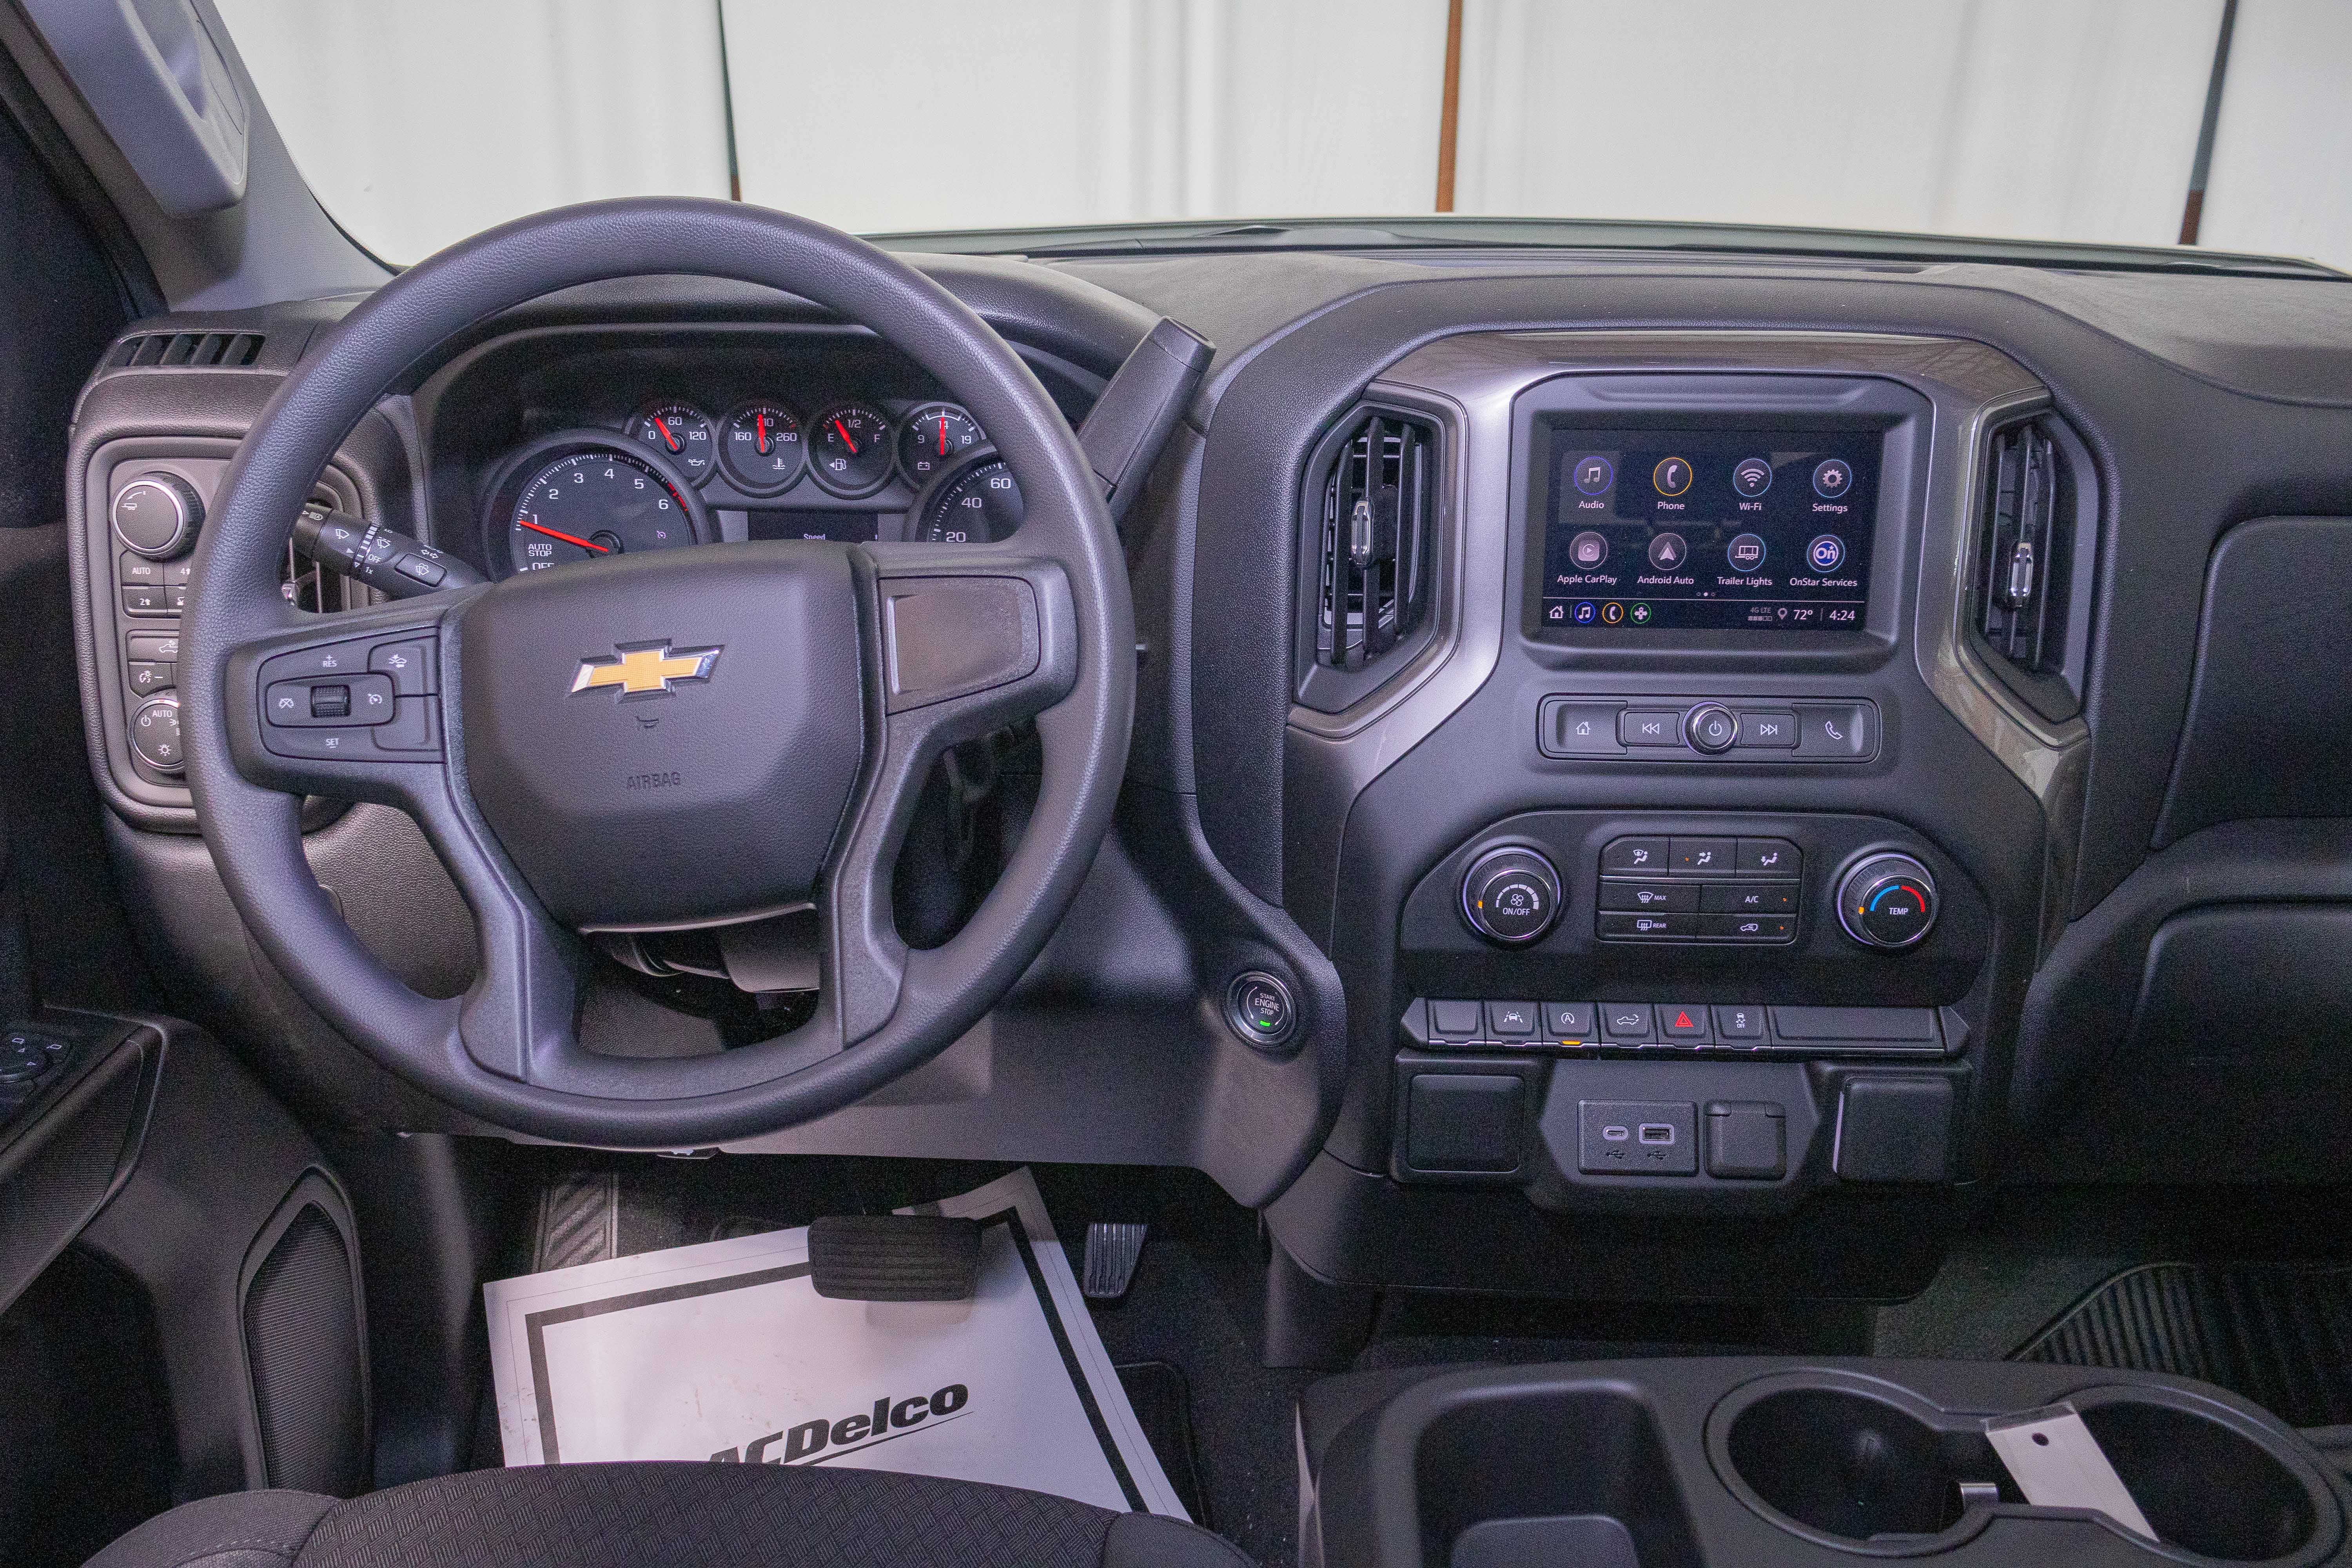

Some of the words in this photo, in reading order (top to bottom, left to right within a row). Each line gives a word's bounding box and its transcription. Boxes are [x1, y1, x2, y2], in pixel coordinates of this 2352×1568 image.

[668, 417, 682, 425] 60
[758, 418, 773, 426] 10
[848, 419, 861, 428] 1/2
[648, 431, 655, 439] 0
[689, 432, 706, 440] 120
[734, 432, 751, 441] 160
[776, 433, 797, 441] 260
[828, 433, 834, 442] E
[874, 434, 880, 443] F
[918, 435, 924, 443] 9
[961, 436, 971, 444] 19
[573, 473, 584, 483] 3
[604, 468, 614, 479] 4
[634, 479, 644, 489] 5
[991, 478, 1011, 489] 60
[549, 489, 559, 499] 2
[659, 499, 669, 510] 6
[961, 497, 982, 508] 40
[1578, 501, 1605, 509] Audio
[1657, 501, 1685, 510] Phone
[1812, 503, 1848, 514] Settings
[532, 514, 538, 524] 1
[946, 532, 966, 542] 20
[368, 554, 383, 563] OFF
[366, 566, 374, 575] 1x
[1557, 575, 1583, 584] Apple
[1585, 575, 1617, 585] CarPlay
[1673, 576, 1694, 584] Auto
[1717, 577, 1744, 585] Trailer
[1746, 577, 1772, 587] Lights
[1822, 578, 1857, 586] Services
[1829, 610, 1855, 621] 4:24
[627, 771, 681, 790] AIRBAG
[1502, 907, 1530, 916] ON/OFF
[1260, 993, 1275, 1001] START
[1255, 998, 1279, 1012] ENGINE
[1260, 1007, 1274, 1016] STOP
